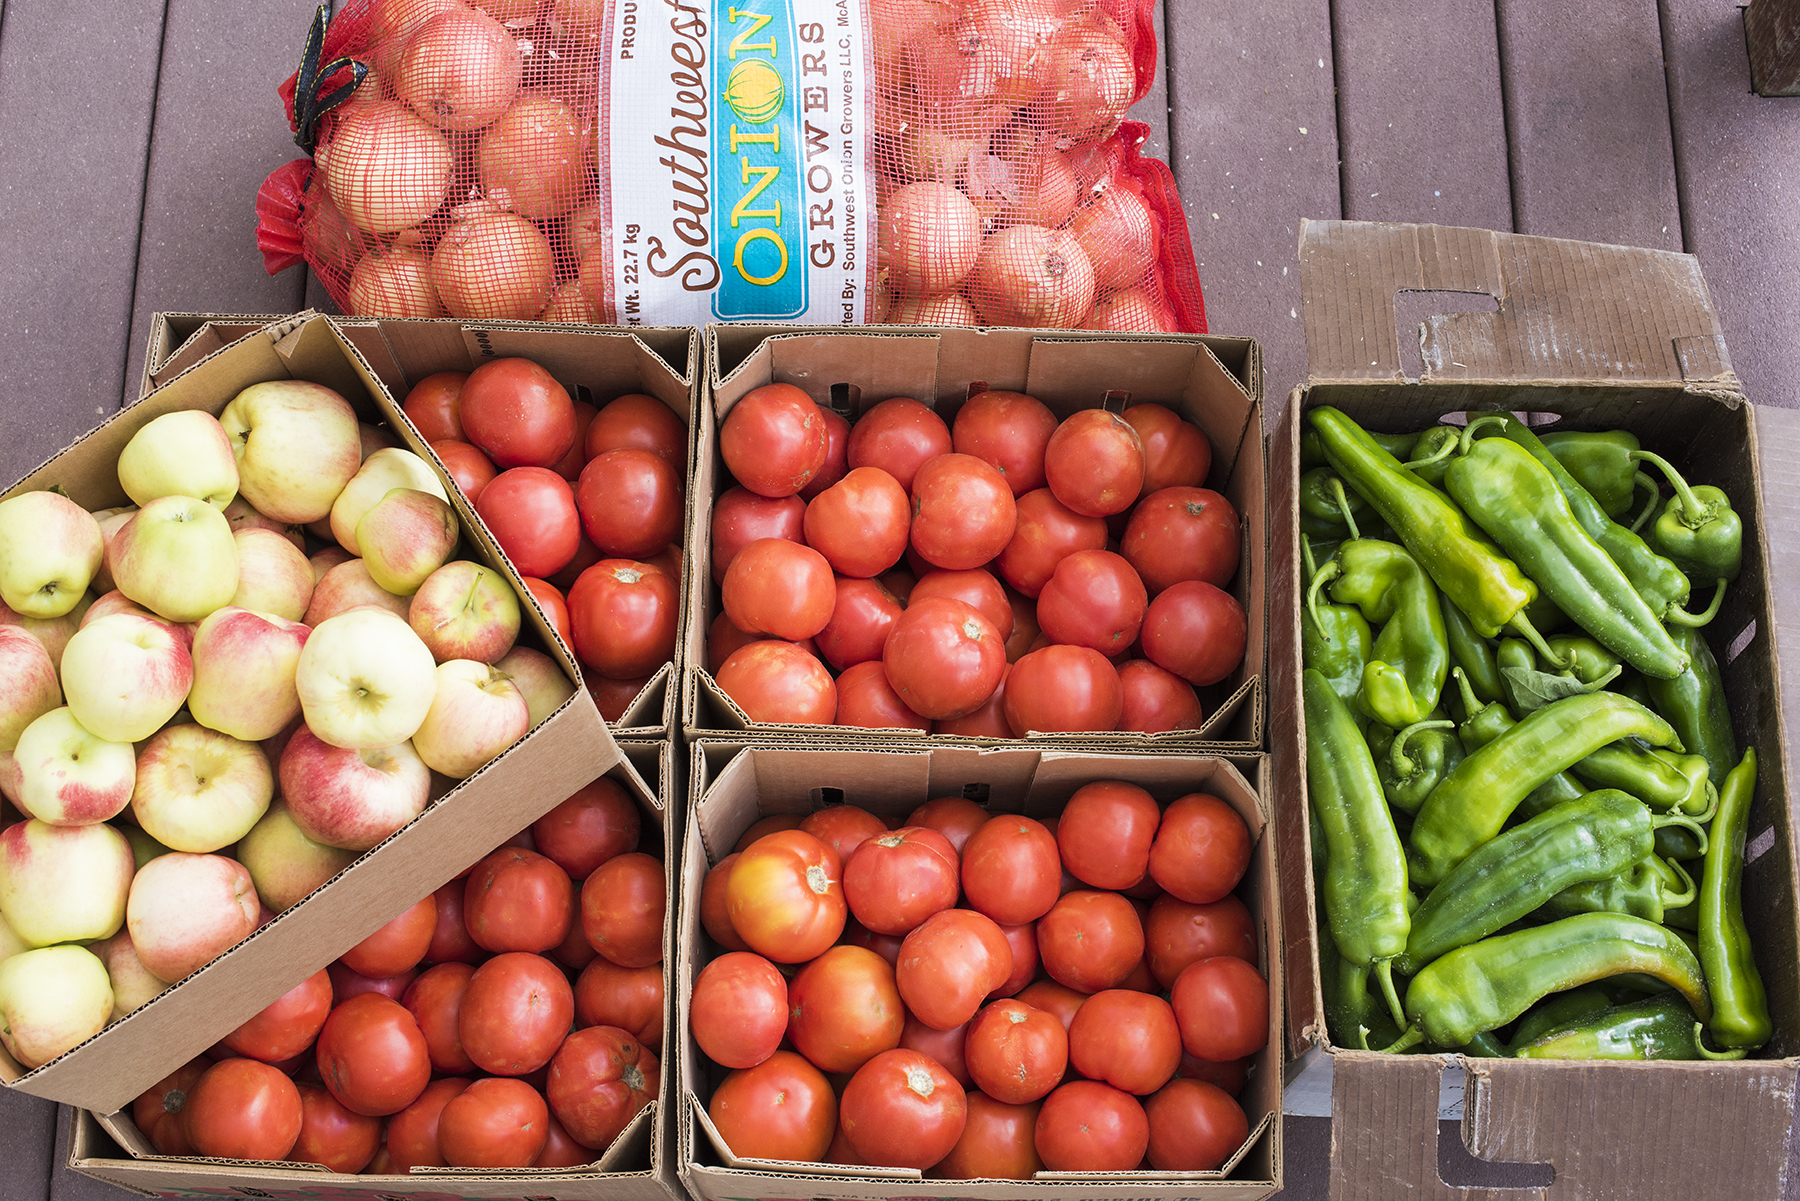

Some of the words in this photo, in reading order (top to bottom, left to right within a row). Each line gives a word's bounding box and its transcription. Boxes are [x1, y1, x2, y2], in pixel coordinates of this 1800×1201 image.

[620, 0, 638, 60] PRODU
[838, 34, 853, 67] LLC,
[840, 70, 853, 135] Growers
[646, 0, 721, 292] Southwest
[721, 6, 790, 287] ONION
[799, 22, 836, 269] GROWERS
[841, 140, 853, 184] Onion
[623, 223, 641, 244] kg
[843, 189, 856, 271] Southwest
[623, 249, 639, 285] 22.7
[841, 278, 857, 299] By:
[624, 289, 641, 314] Wt.
